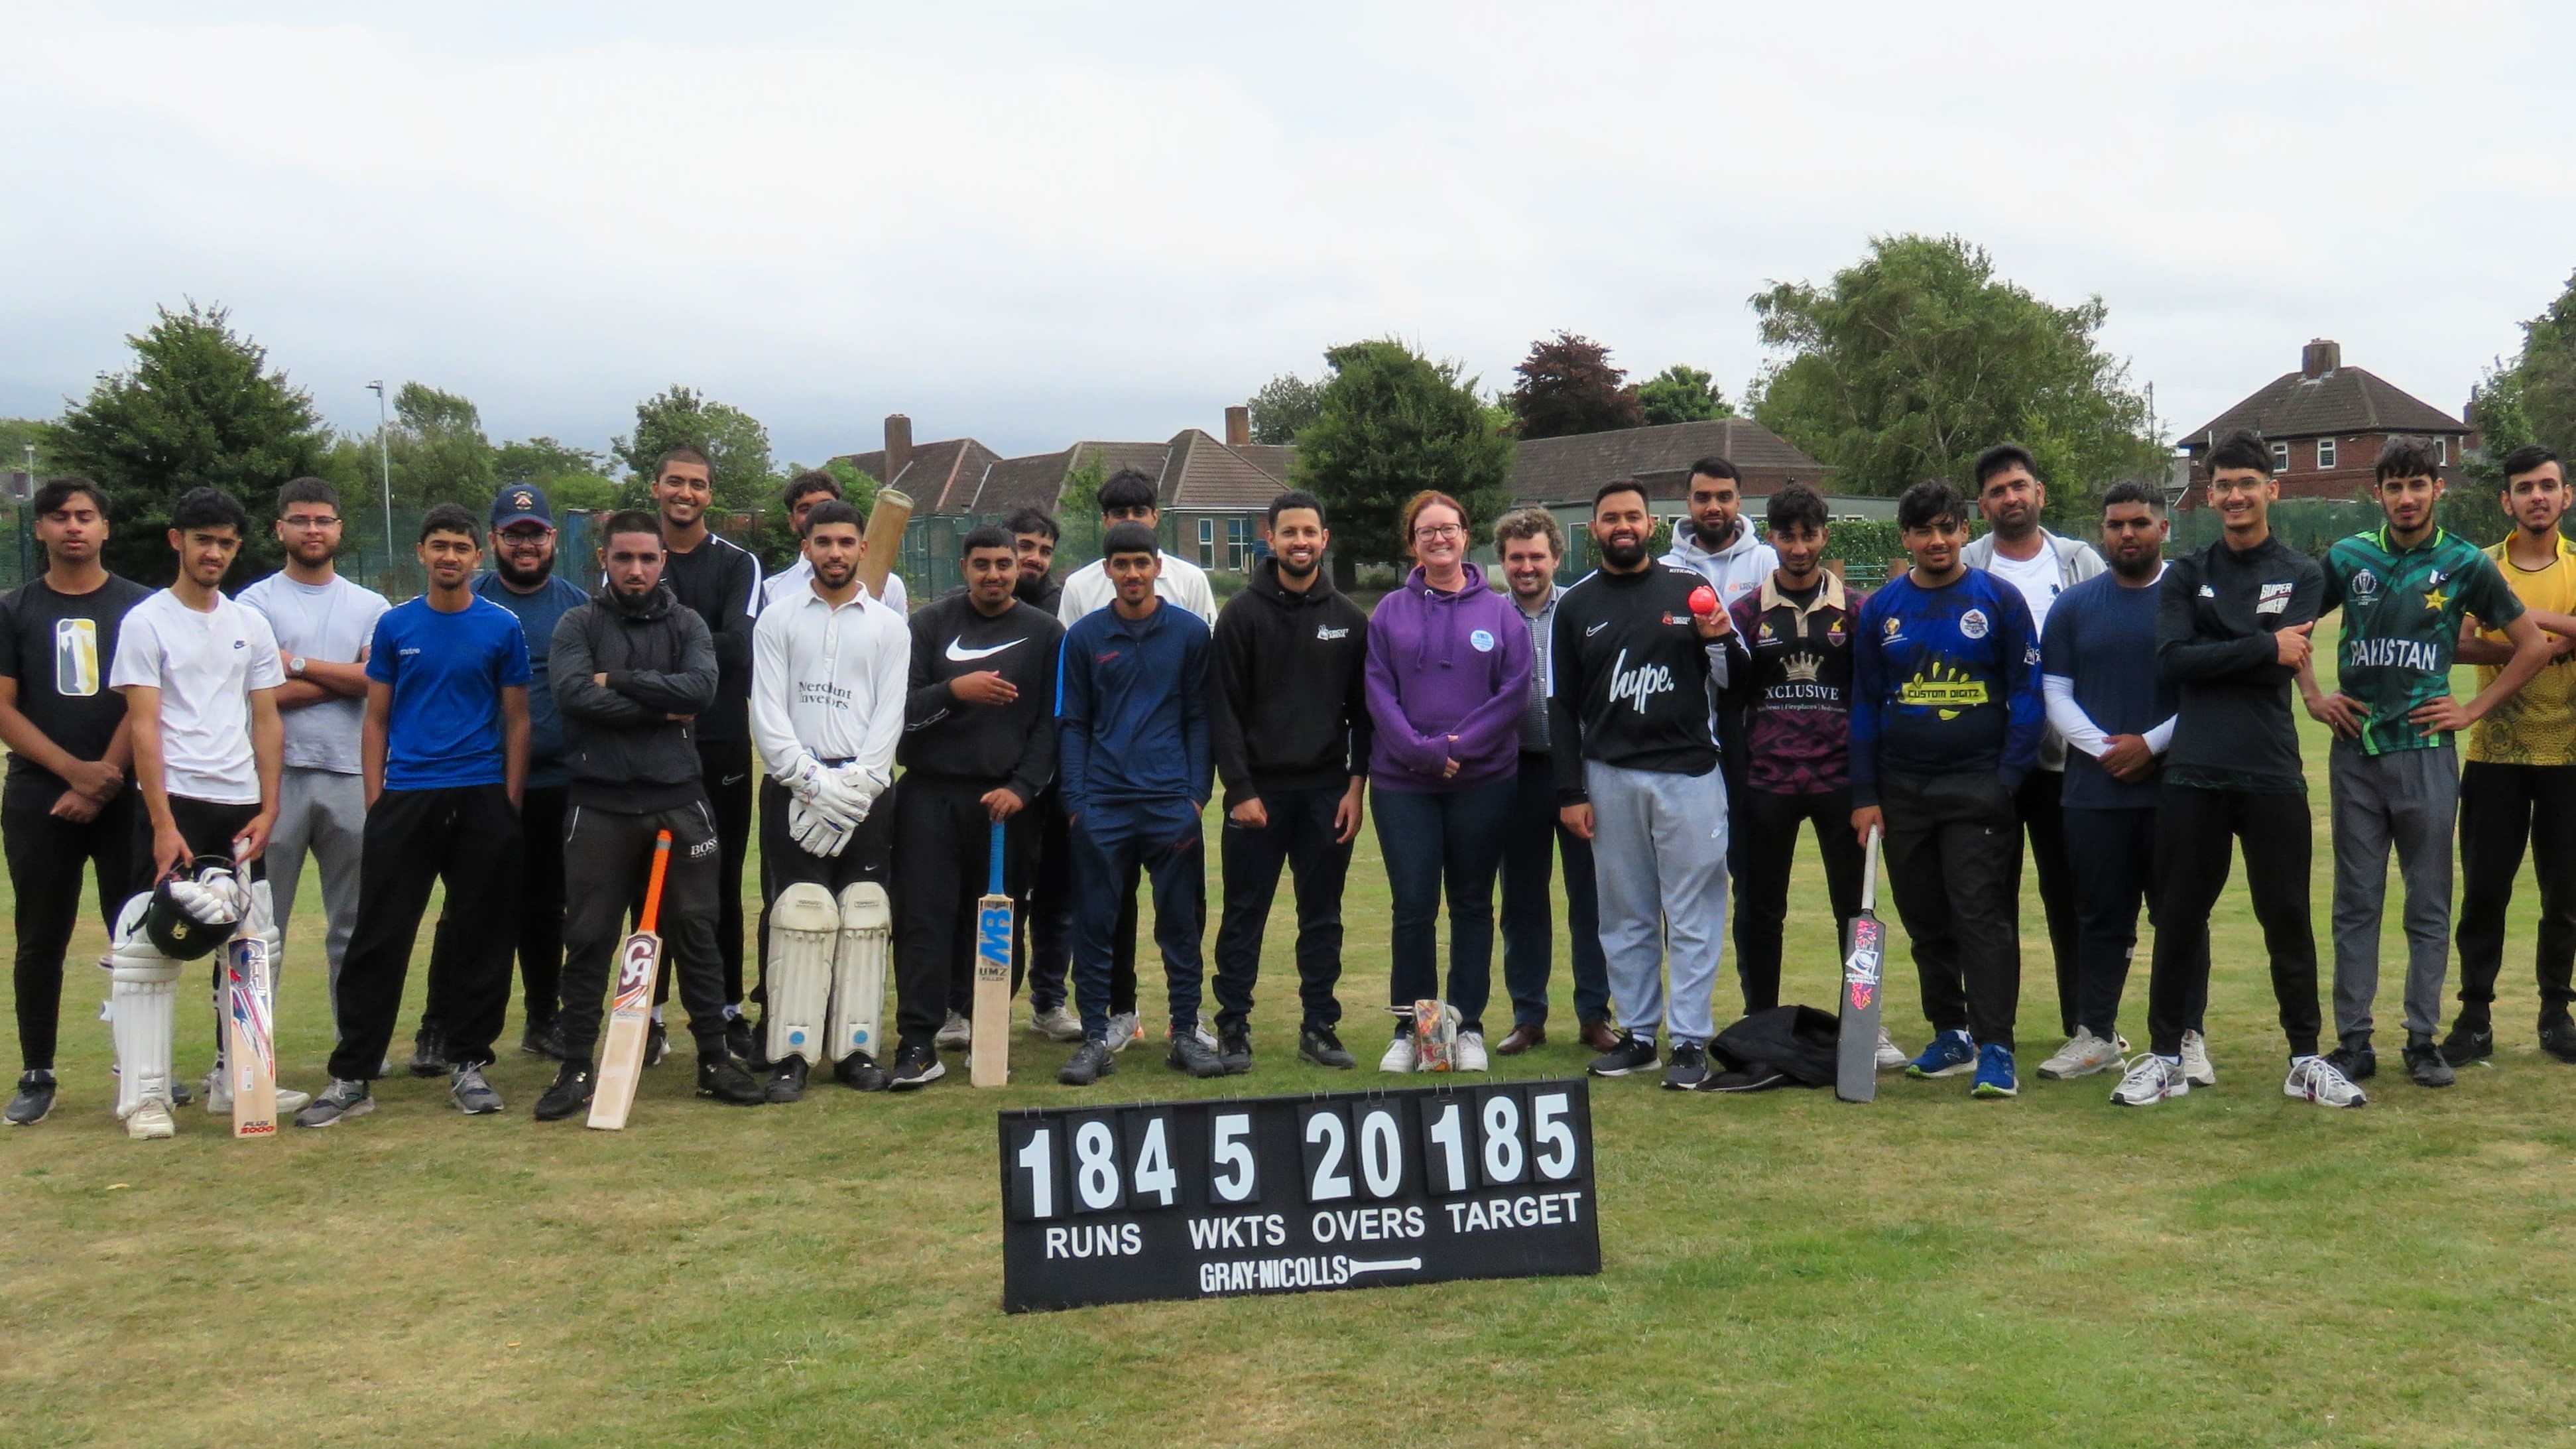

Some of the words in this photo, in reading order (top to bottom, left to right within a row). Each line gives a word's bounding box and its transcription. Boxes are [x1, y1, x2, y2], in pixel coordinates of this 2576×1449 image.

[2259, 583, 2292, 600] SUPER
[2351, 639, 2437, 670] PAKISTAN
[1609, 649, 1674, 714] hype.
[800, 693, 848, 710] Invesors
[1019, 1118, 1177, 1218] 184
[1214, 1113, 1255, 1201] 5
[1306, 1111, 1402, 1200] 20
[1430, 1093, 1575, 1191] 185
[1046, 1223, 1142, 1259] RUNS
[1188, 1214, 1286, 1250] WKTS
[1312, 1206, 1425, 1243] OVERS
[1445, 1192, 1581, 1233] TARGET
[1200, 1255, 1349, 1292] GRAY-NICOLLS
